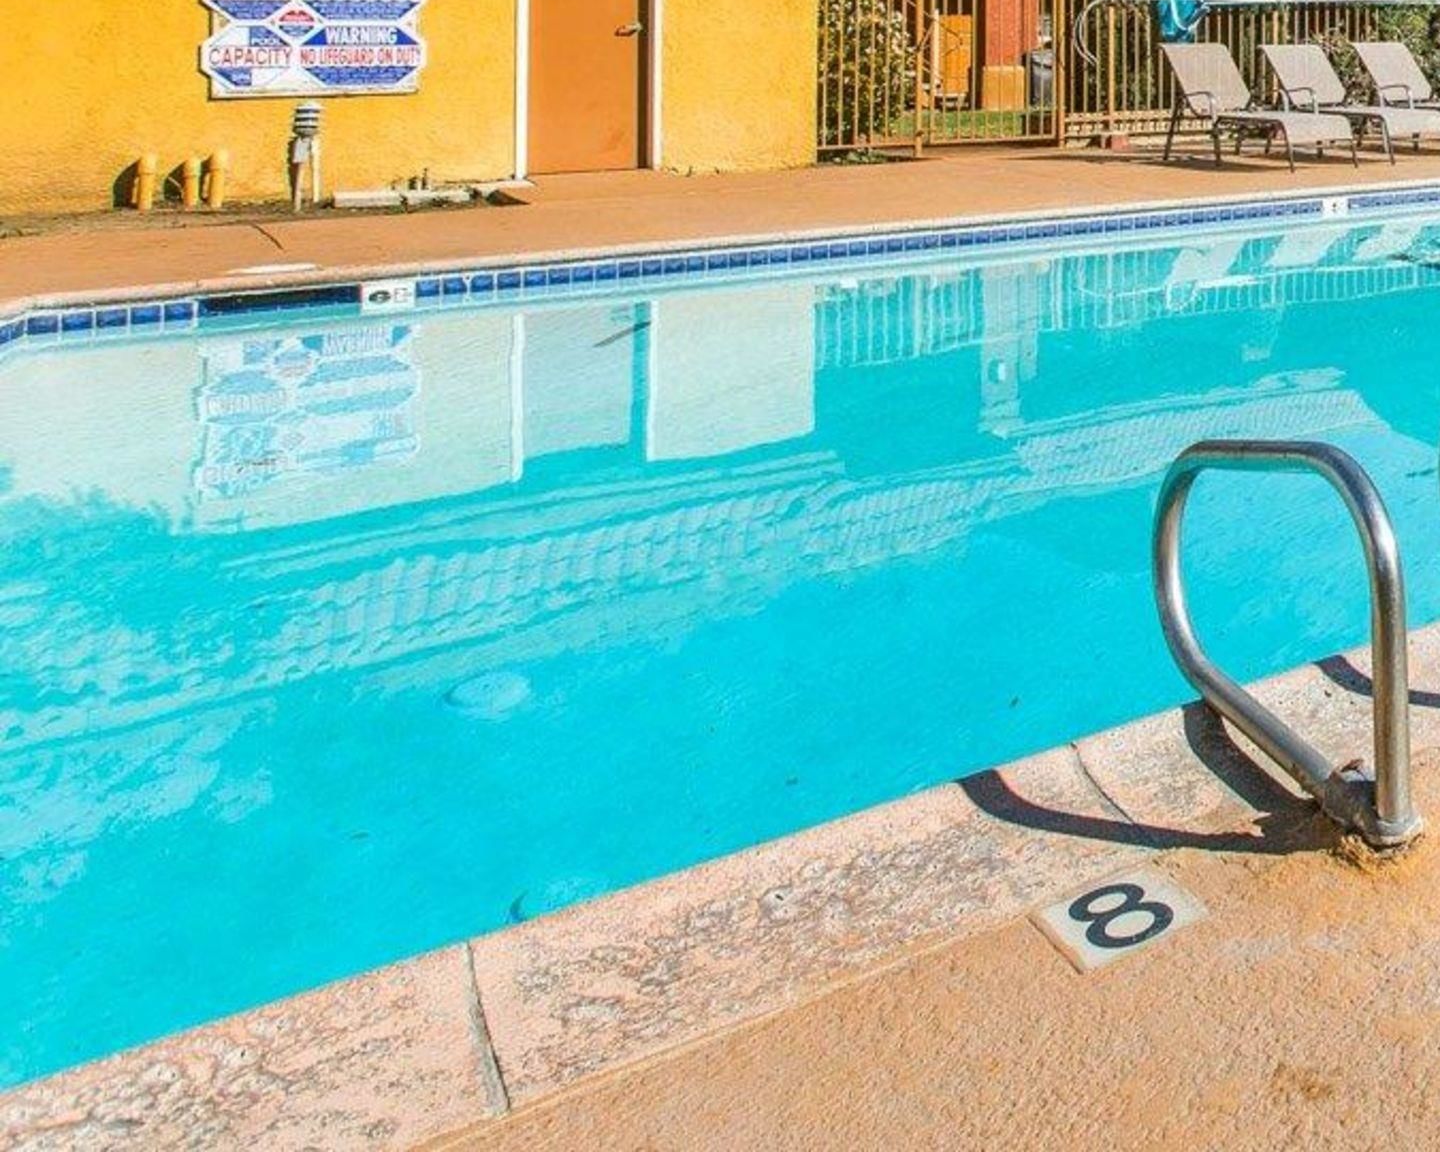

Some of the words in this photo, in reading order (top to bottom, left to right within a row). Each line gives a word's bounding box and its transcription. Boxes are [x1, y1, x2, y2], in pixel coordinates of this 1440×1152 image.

[325, 27, 398, 44] WARNING
[209, 48, 292, 66] CAPACITY
[300, 48, 316, 65] NO
[320, 48, 374, 65] LIFEGUARD
[378, 48, 393, 65] ON
[1068, 883, 1174, 948] 8
